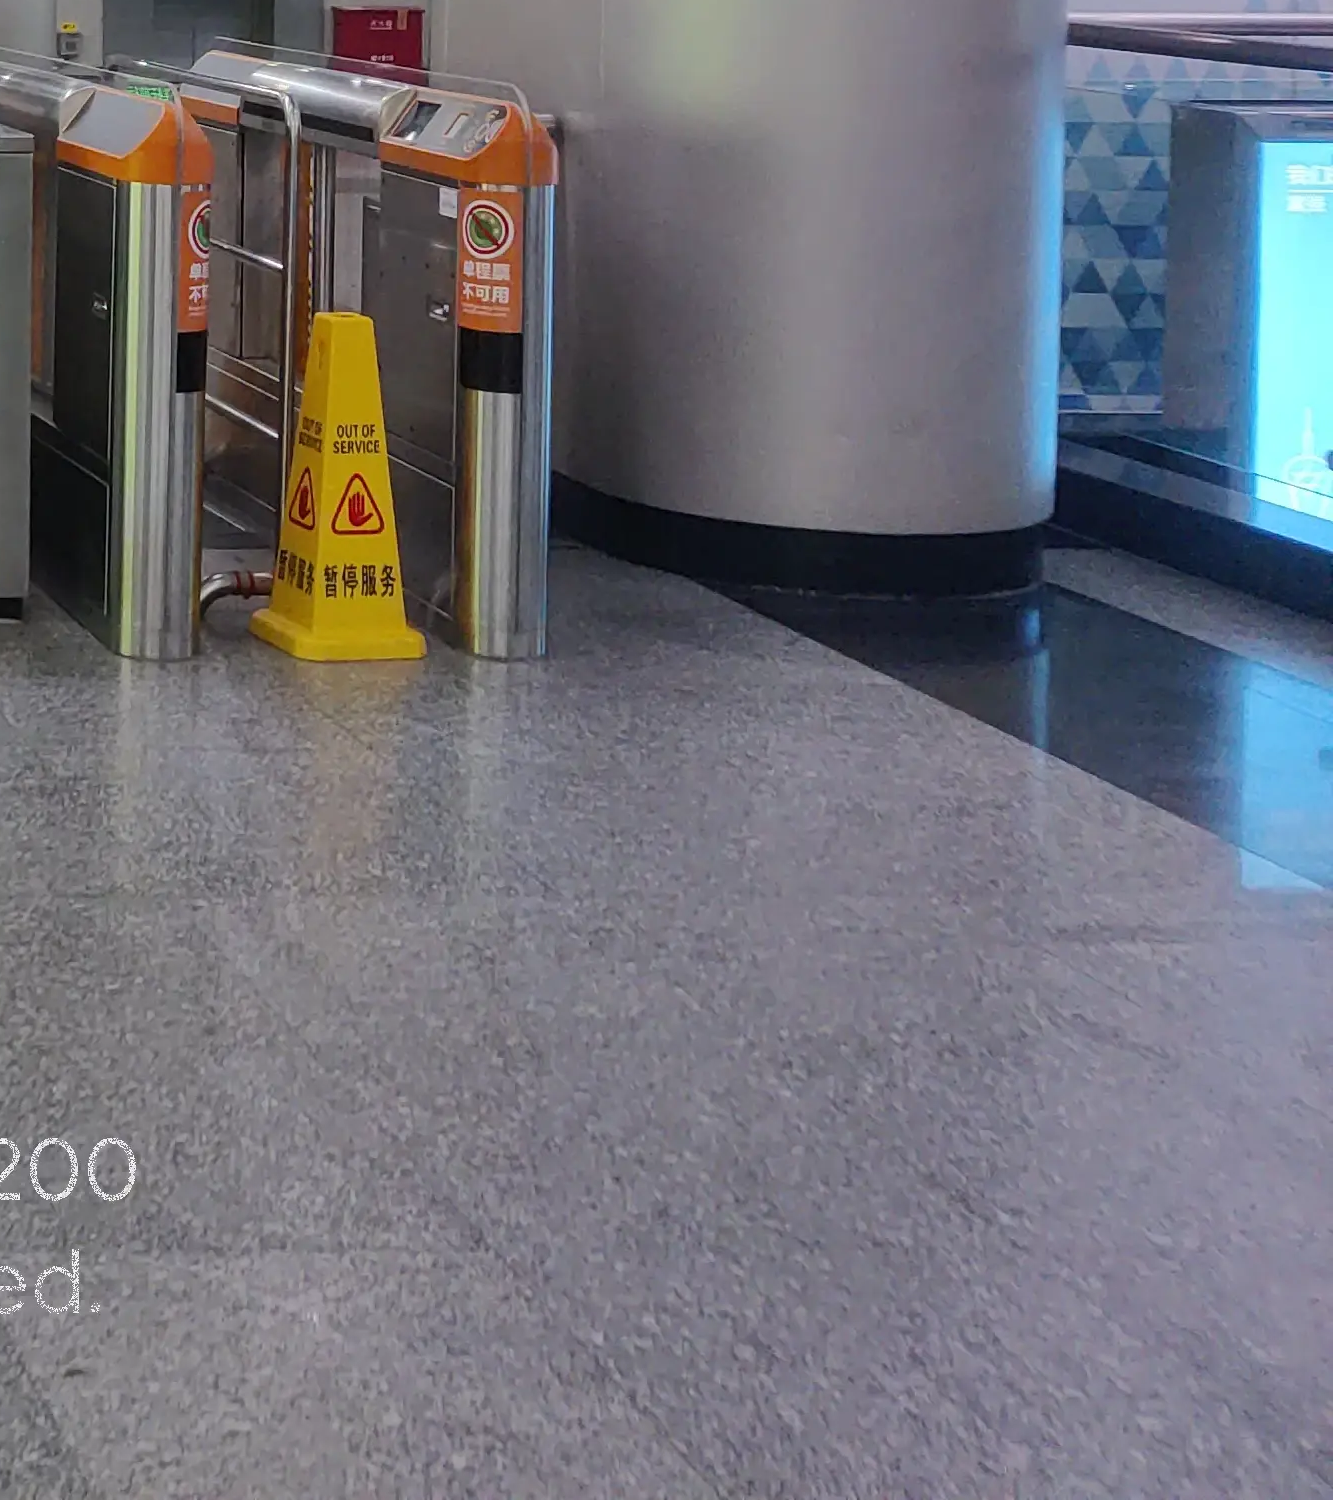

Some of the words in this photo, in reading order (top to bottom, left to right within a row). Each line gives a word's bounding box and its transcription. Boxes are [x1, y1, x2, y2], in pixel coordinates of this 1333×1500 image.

[462, 281, 510, 304] 不可用
[336, 424, 359, 439] OUT
[361, 424, 376, 438] OF
[332, 440, 381, 455] SERVICE
[324, 563, 397, 599] 暂停服务
